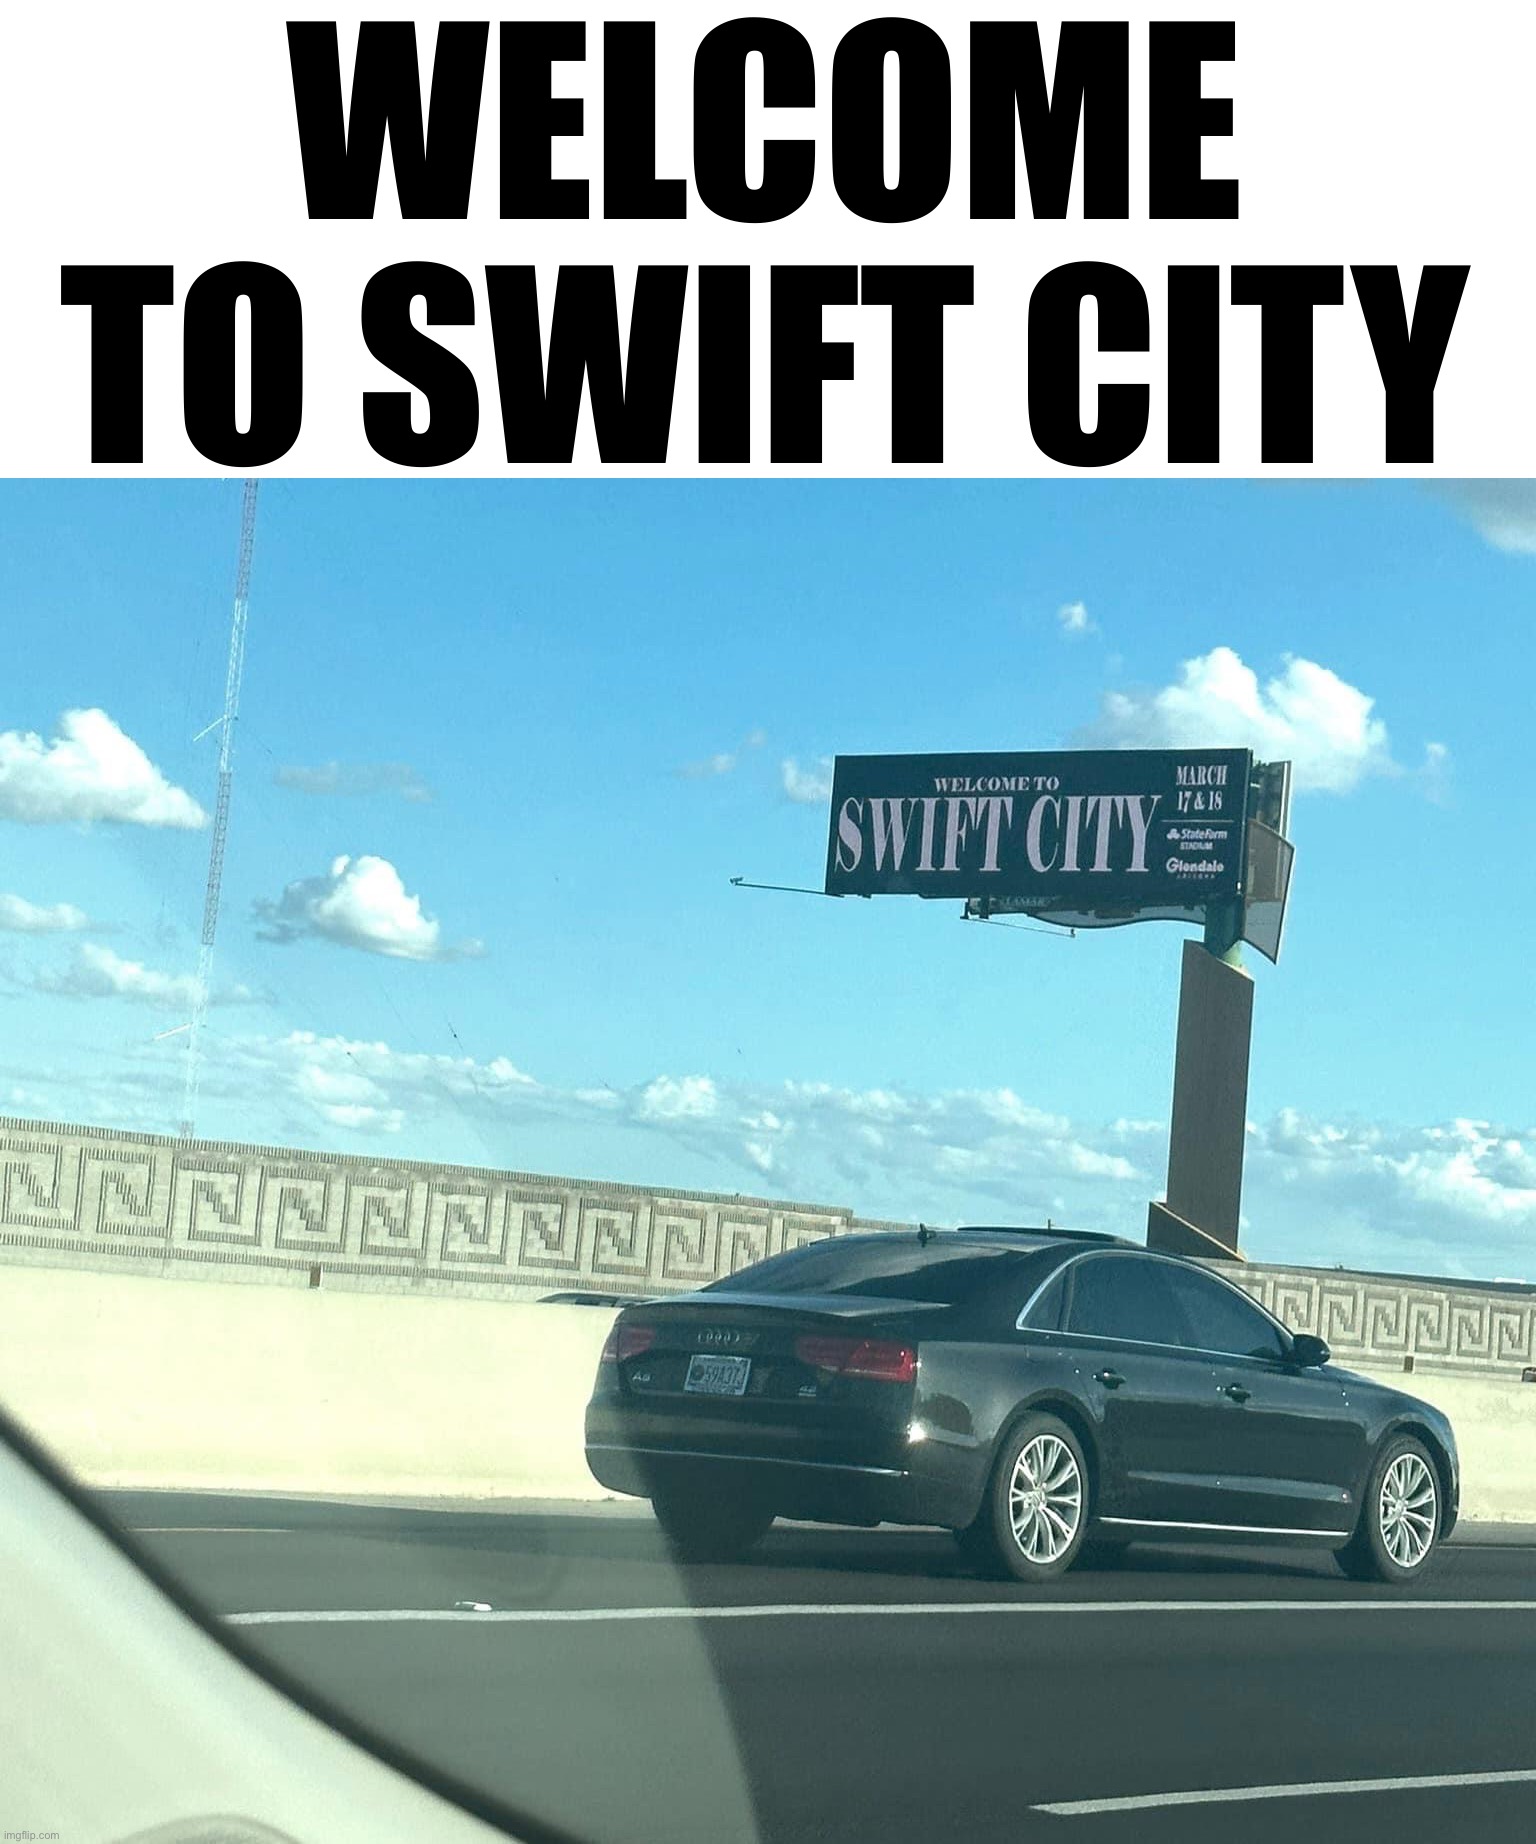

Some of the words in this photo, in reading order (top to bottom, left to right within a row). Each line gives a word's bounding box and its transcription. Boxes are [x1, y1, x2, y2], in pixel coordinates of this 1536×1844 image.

[934, 776, 1031, 793] WELCOME
[1033, 775, 1061, 791] TO
[1175, 765, 1228, 786] MARCH
[1178, 790, 1193, 813] 17
[1193, 790, 1206, 811] &
[1207, 790, 1223, 811] 18
[834, 796, 1014, 873] SWIFT
[1026, 795, 1163, 873] CITY
[1180, 841, 1213, 851] STADIUM
[1165, 857, 1225, 873] Glendale
